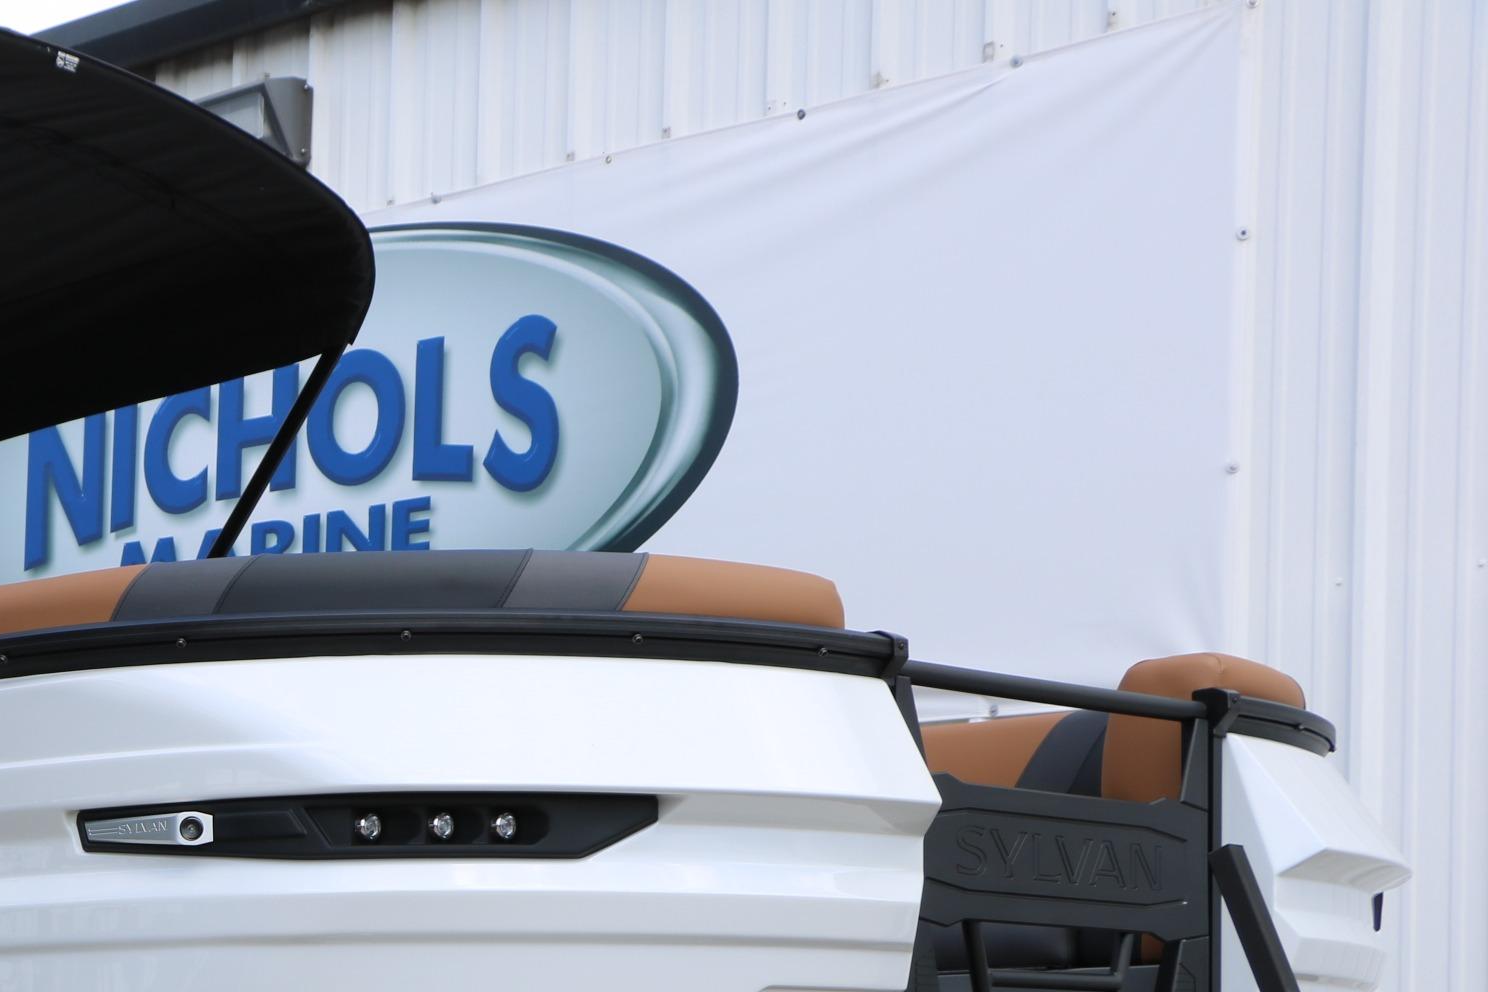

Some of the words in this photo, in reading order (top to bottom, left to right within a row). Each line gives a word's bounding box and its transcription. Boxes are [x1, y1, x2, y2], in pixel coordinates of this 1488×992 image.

[24, 314, 559, 572] NICHOLS
[117, 819, 168, 836] SYLVAN
[955, 824, 1163, 891] SYLVAN
